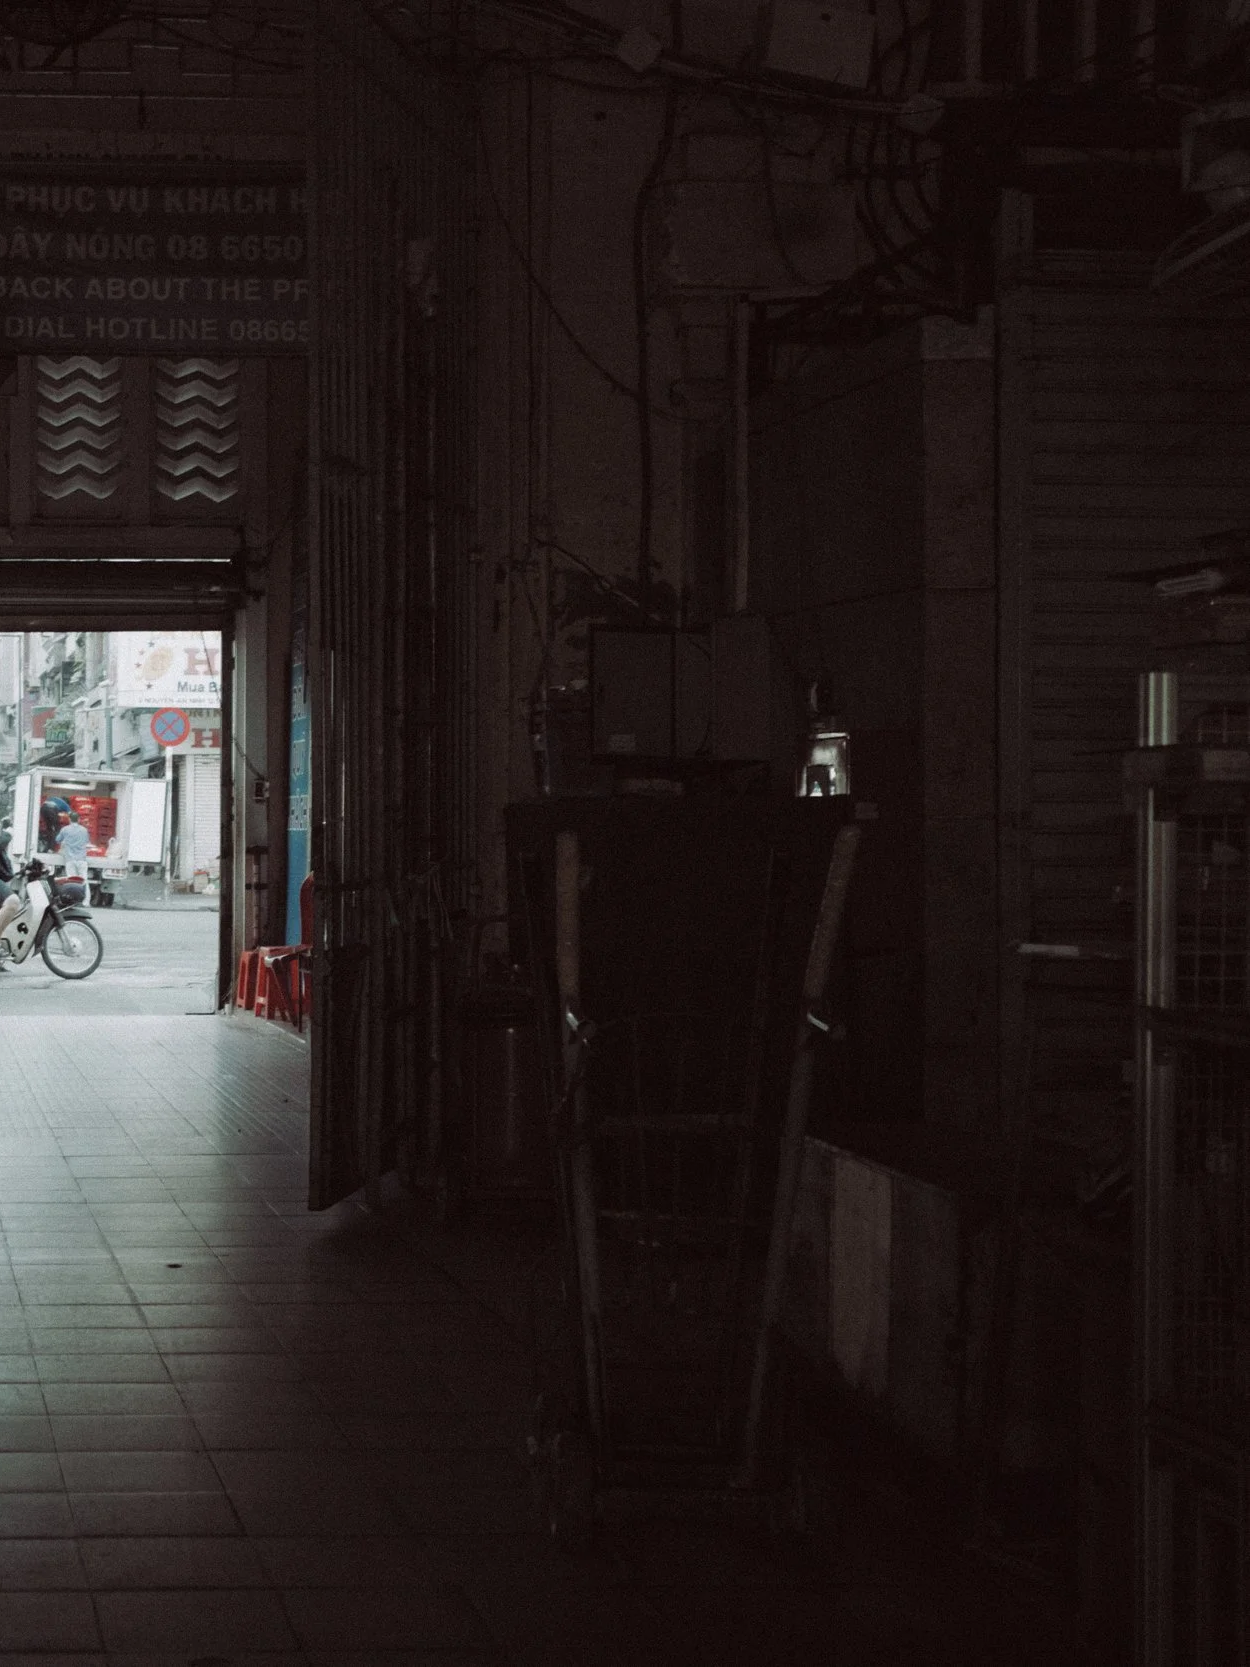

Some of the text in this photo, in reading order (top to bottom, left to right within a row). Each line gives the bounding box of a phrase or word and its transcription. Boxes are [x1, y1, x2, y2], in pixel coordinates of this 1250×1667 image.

[167, 234, 209, 261] 08
[85, 277, 191, 301] ABOUT
[201, 277, 262, 301] THE
[6, 315, 75, 339] DIAL
[86, 317, 219, 342] HOTLINE
[176, 681, 205, 693] Mua
